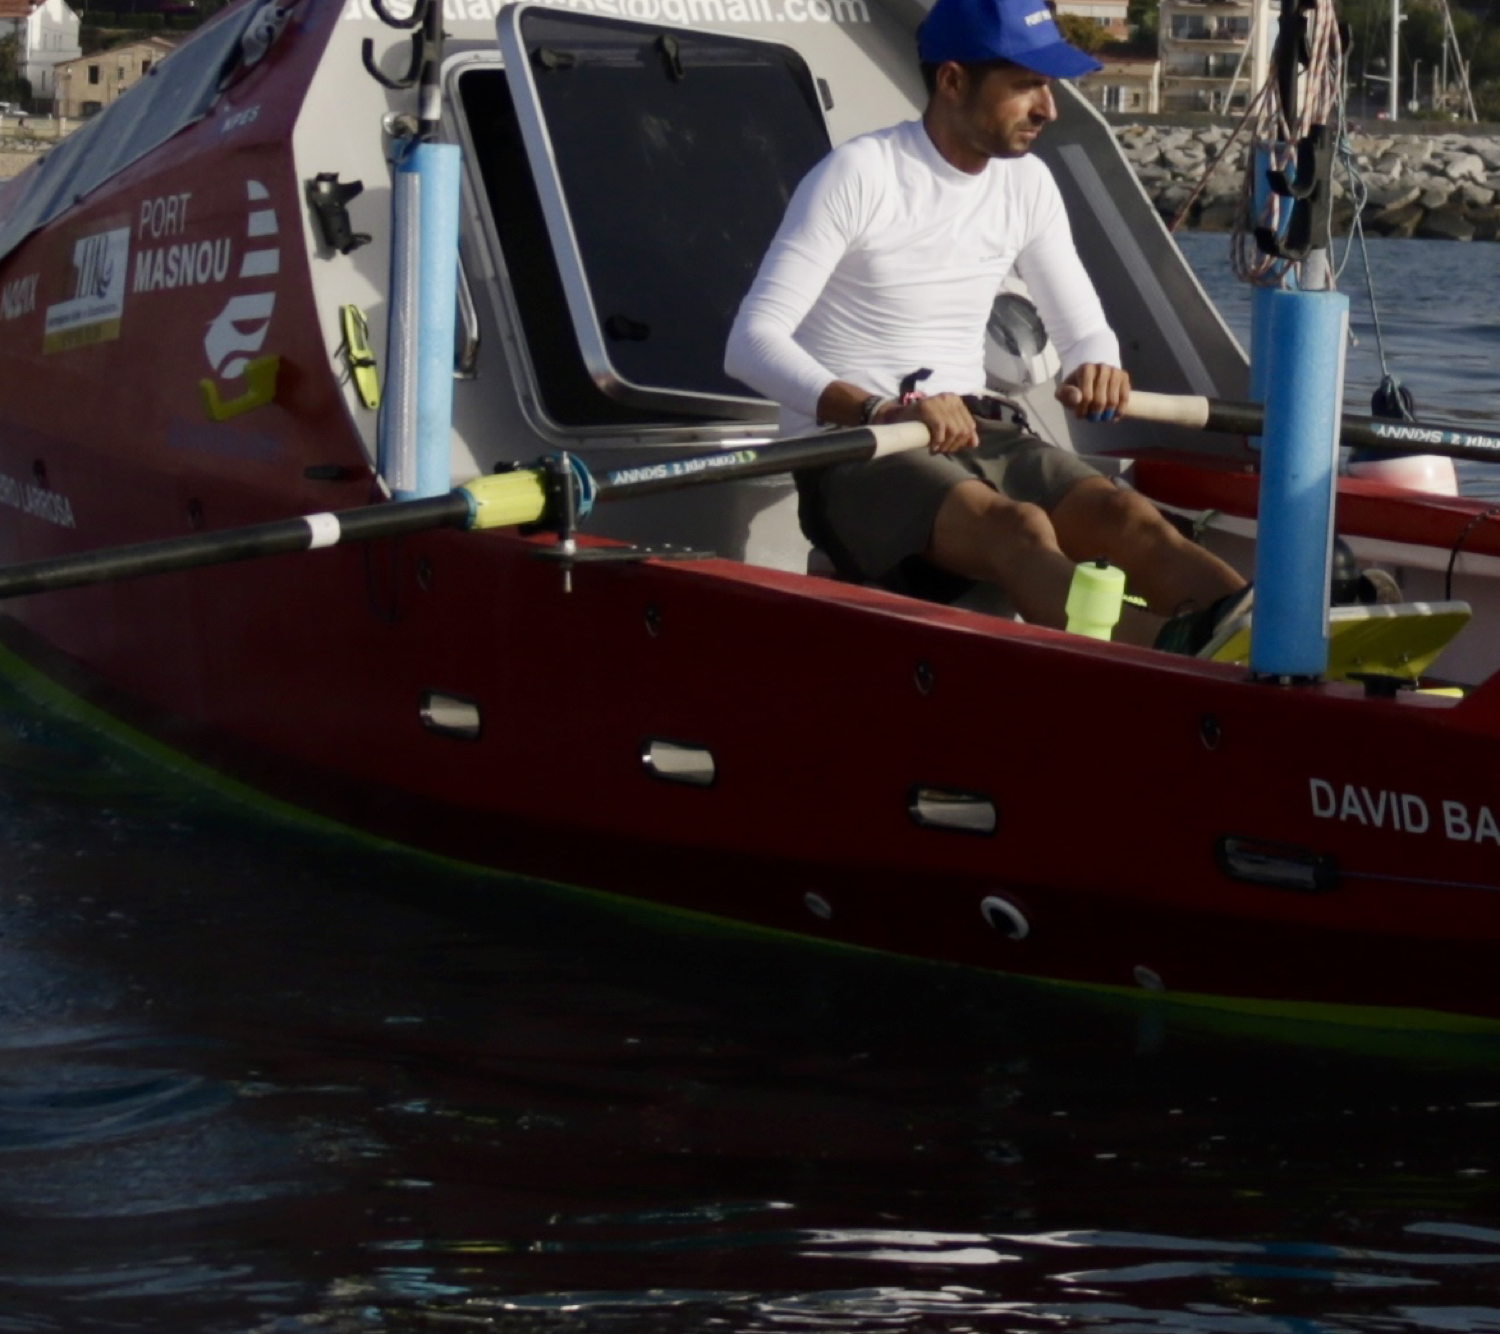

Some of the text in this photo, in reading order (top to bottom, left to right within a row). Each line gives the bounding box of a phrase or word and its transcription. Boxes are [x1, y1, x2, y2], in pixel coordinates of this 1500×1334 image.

[138, 192, 192, 240] PORT
[133, 238, 231, 294] MASNOU
[1376, 425, 1443, 443] SKINNY
[611, 465, 667, 485] SKINNY
[1309, 778, 1430, 834] DAVID
